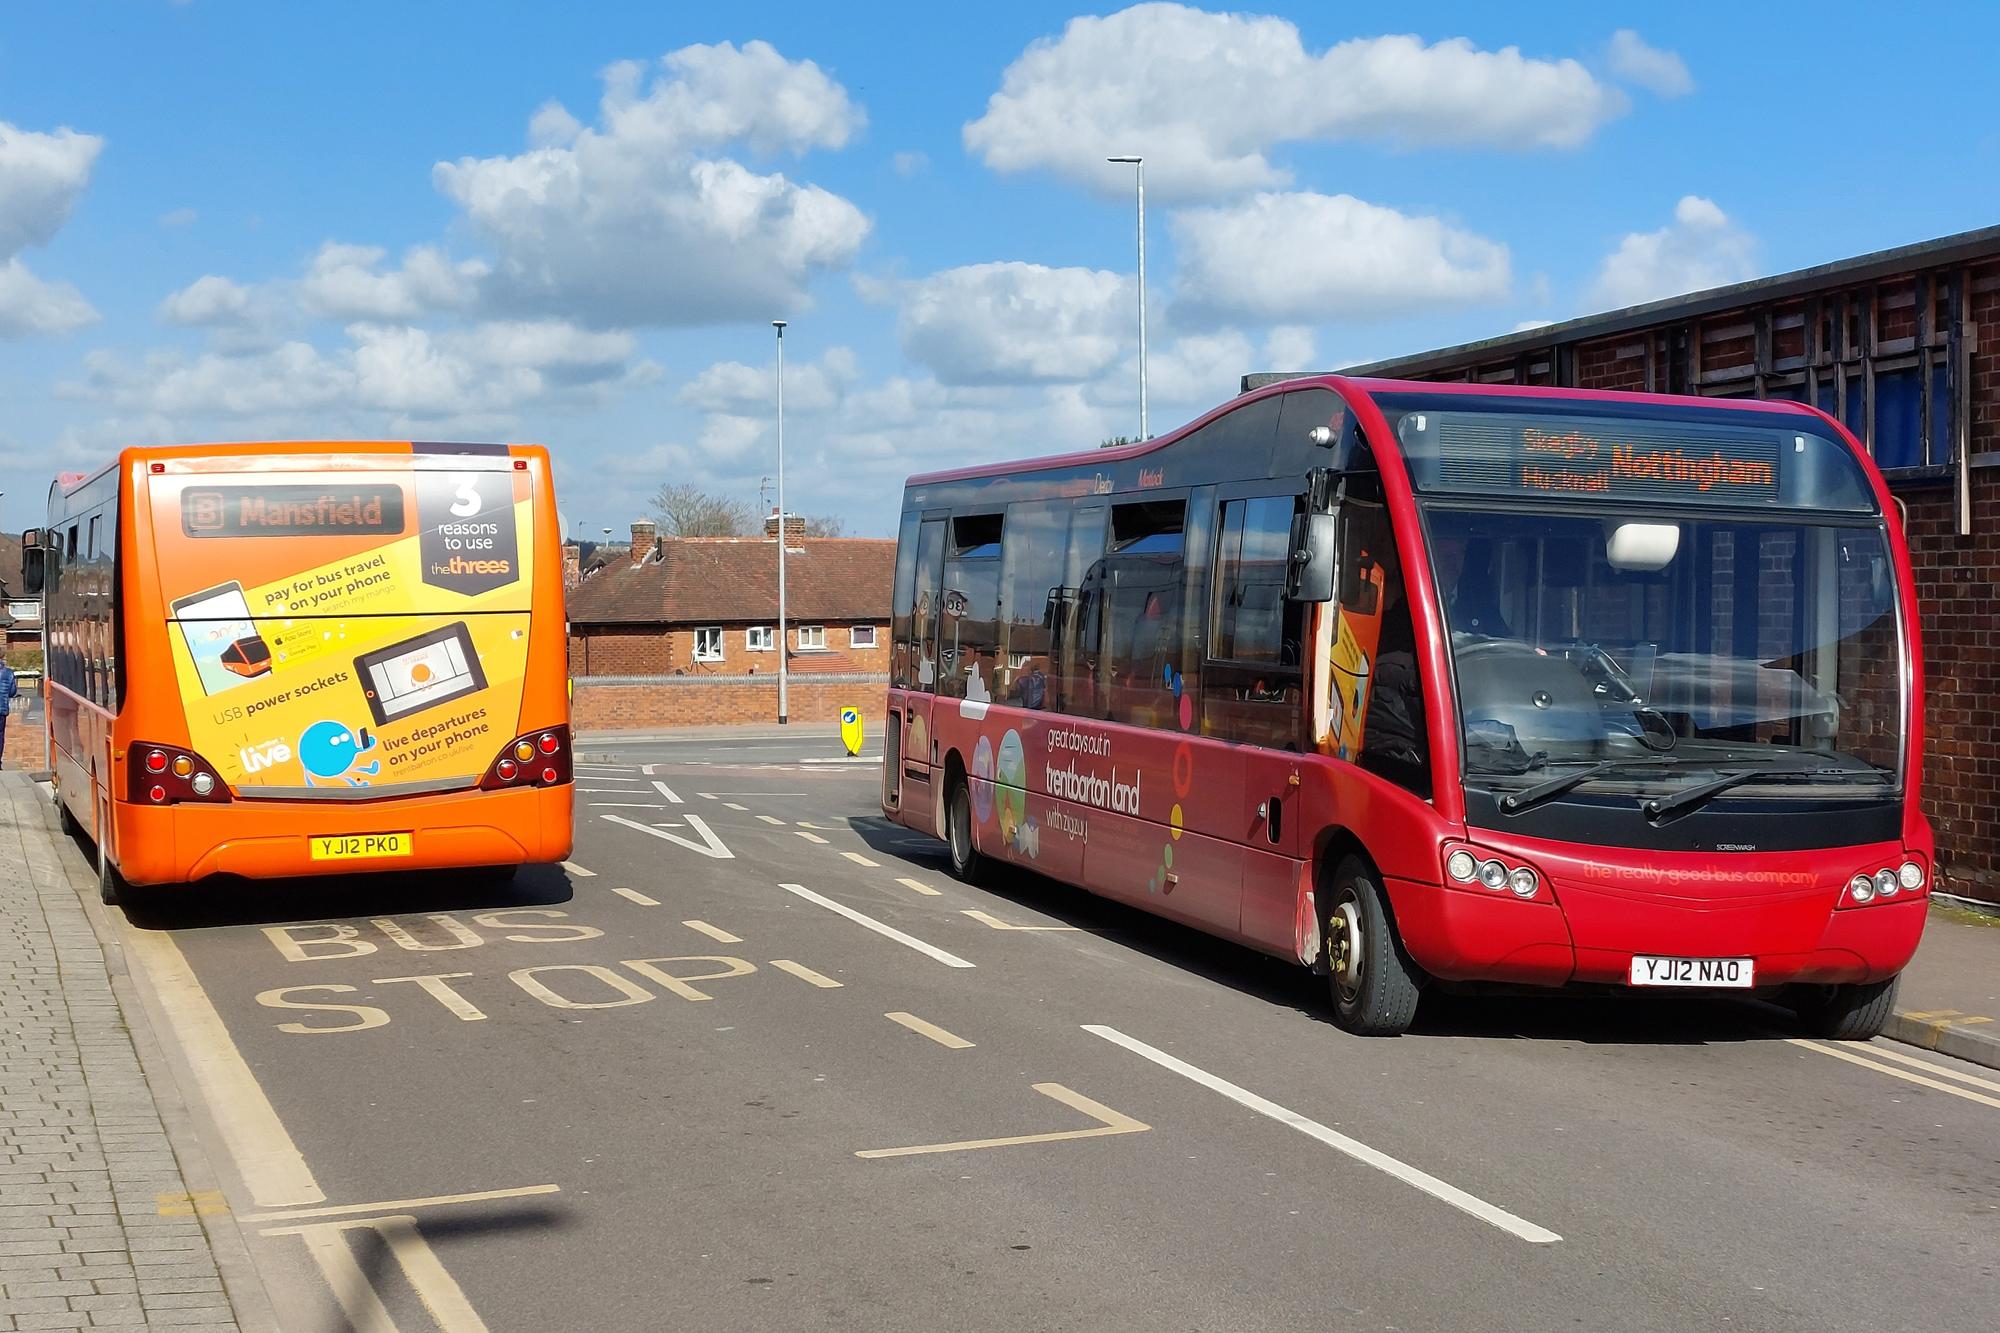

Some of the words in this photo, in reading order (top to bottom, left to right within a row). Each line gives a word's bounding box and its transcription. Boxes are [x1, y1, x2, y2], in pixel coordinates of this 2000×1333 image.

[1095, 472, 1115, 495] Derby
[1613, 443, 1773, 492] Nottingham
[239, 495, 383, 527] Mansfield
[448, 472, 482, 517] 3
[438, 523, 498, 535] reasons
[444, 536, 462, 550] to
[465, 537, 493, 550] use
[265, 588, 290, 605] pay
[293, 580, 314, 593] for
[316, 571, 342, 586] bus
[344, 554, 386, 577] travel
[290, 598, 309, 611] on
[310, 586, 343, 607] your
[346, 571, 391, 595] phone
[322, 596, 351, 613] search
[352, 595, 365, 605] my
[366, 584, 396, 598] mango
[213, 707, 243, 725] USB
[246, 691, 291, 717] power
[294, 671, 349, 697] sockets
[382, 736, 410, 752] live
[411, 708, 487, 741] departures
[389, 753, 408, 766] on
[409, 740, 442, 761] your
[445, 723, 489, 748] phone
[1047, 727, 1068, 753] great
[1069, 722, 1088, 756] days
[1089, 733, 1103, 755] out
[1103, 732, 1111, 757] in
[240, 743, 291, 773] live
[392, 743, 475, 777] trentbarton.co.uk/live
[1046, 757, 1110, 808] trentbarton
[1112, 765, 1140, 815] land
[1046, 803, 1063, 830] with
[323, 838, 360, 855] YJ12
[365, 836, 399, 853] PKO
[1716, 843, 1756, 851] SCREENWASH
[1583, 860, 1612, 879] the
[1615, 863, 1664, 884] really
[1668, 865, 1711, 885] good
[1713, 866, 1744, 882] bus
[1745, 870, 1820, 887] company
[260, 910, 605, 962] BUS
[1646, 959, 1693, 981] YJ12
[1699, 960, 1739, 982] NAO
[255, 955, 758, 1034] STOP
